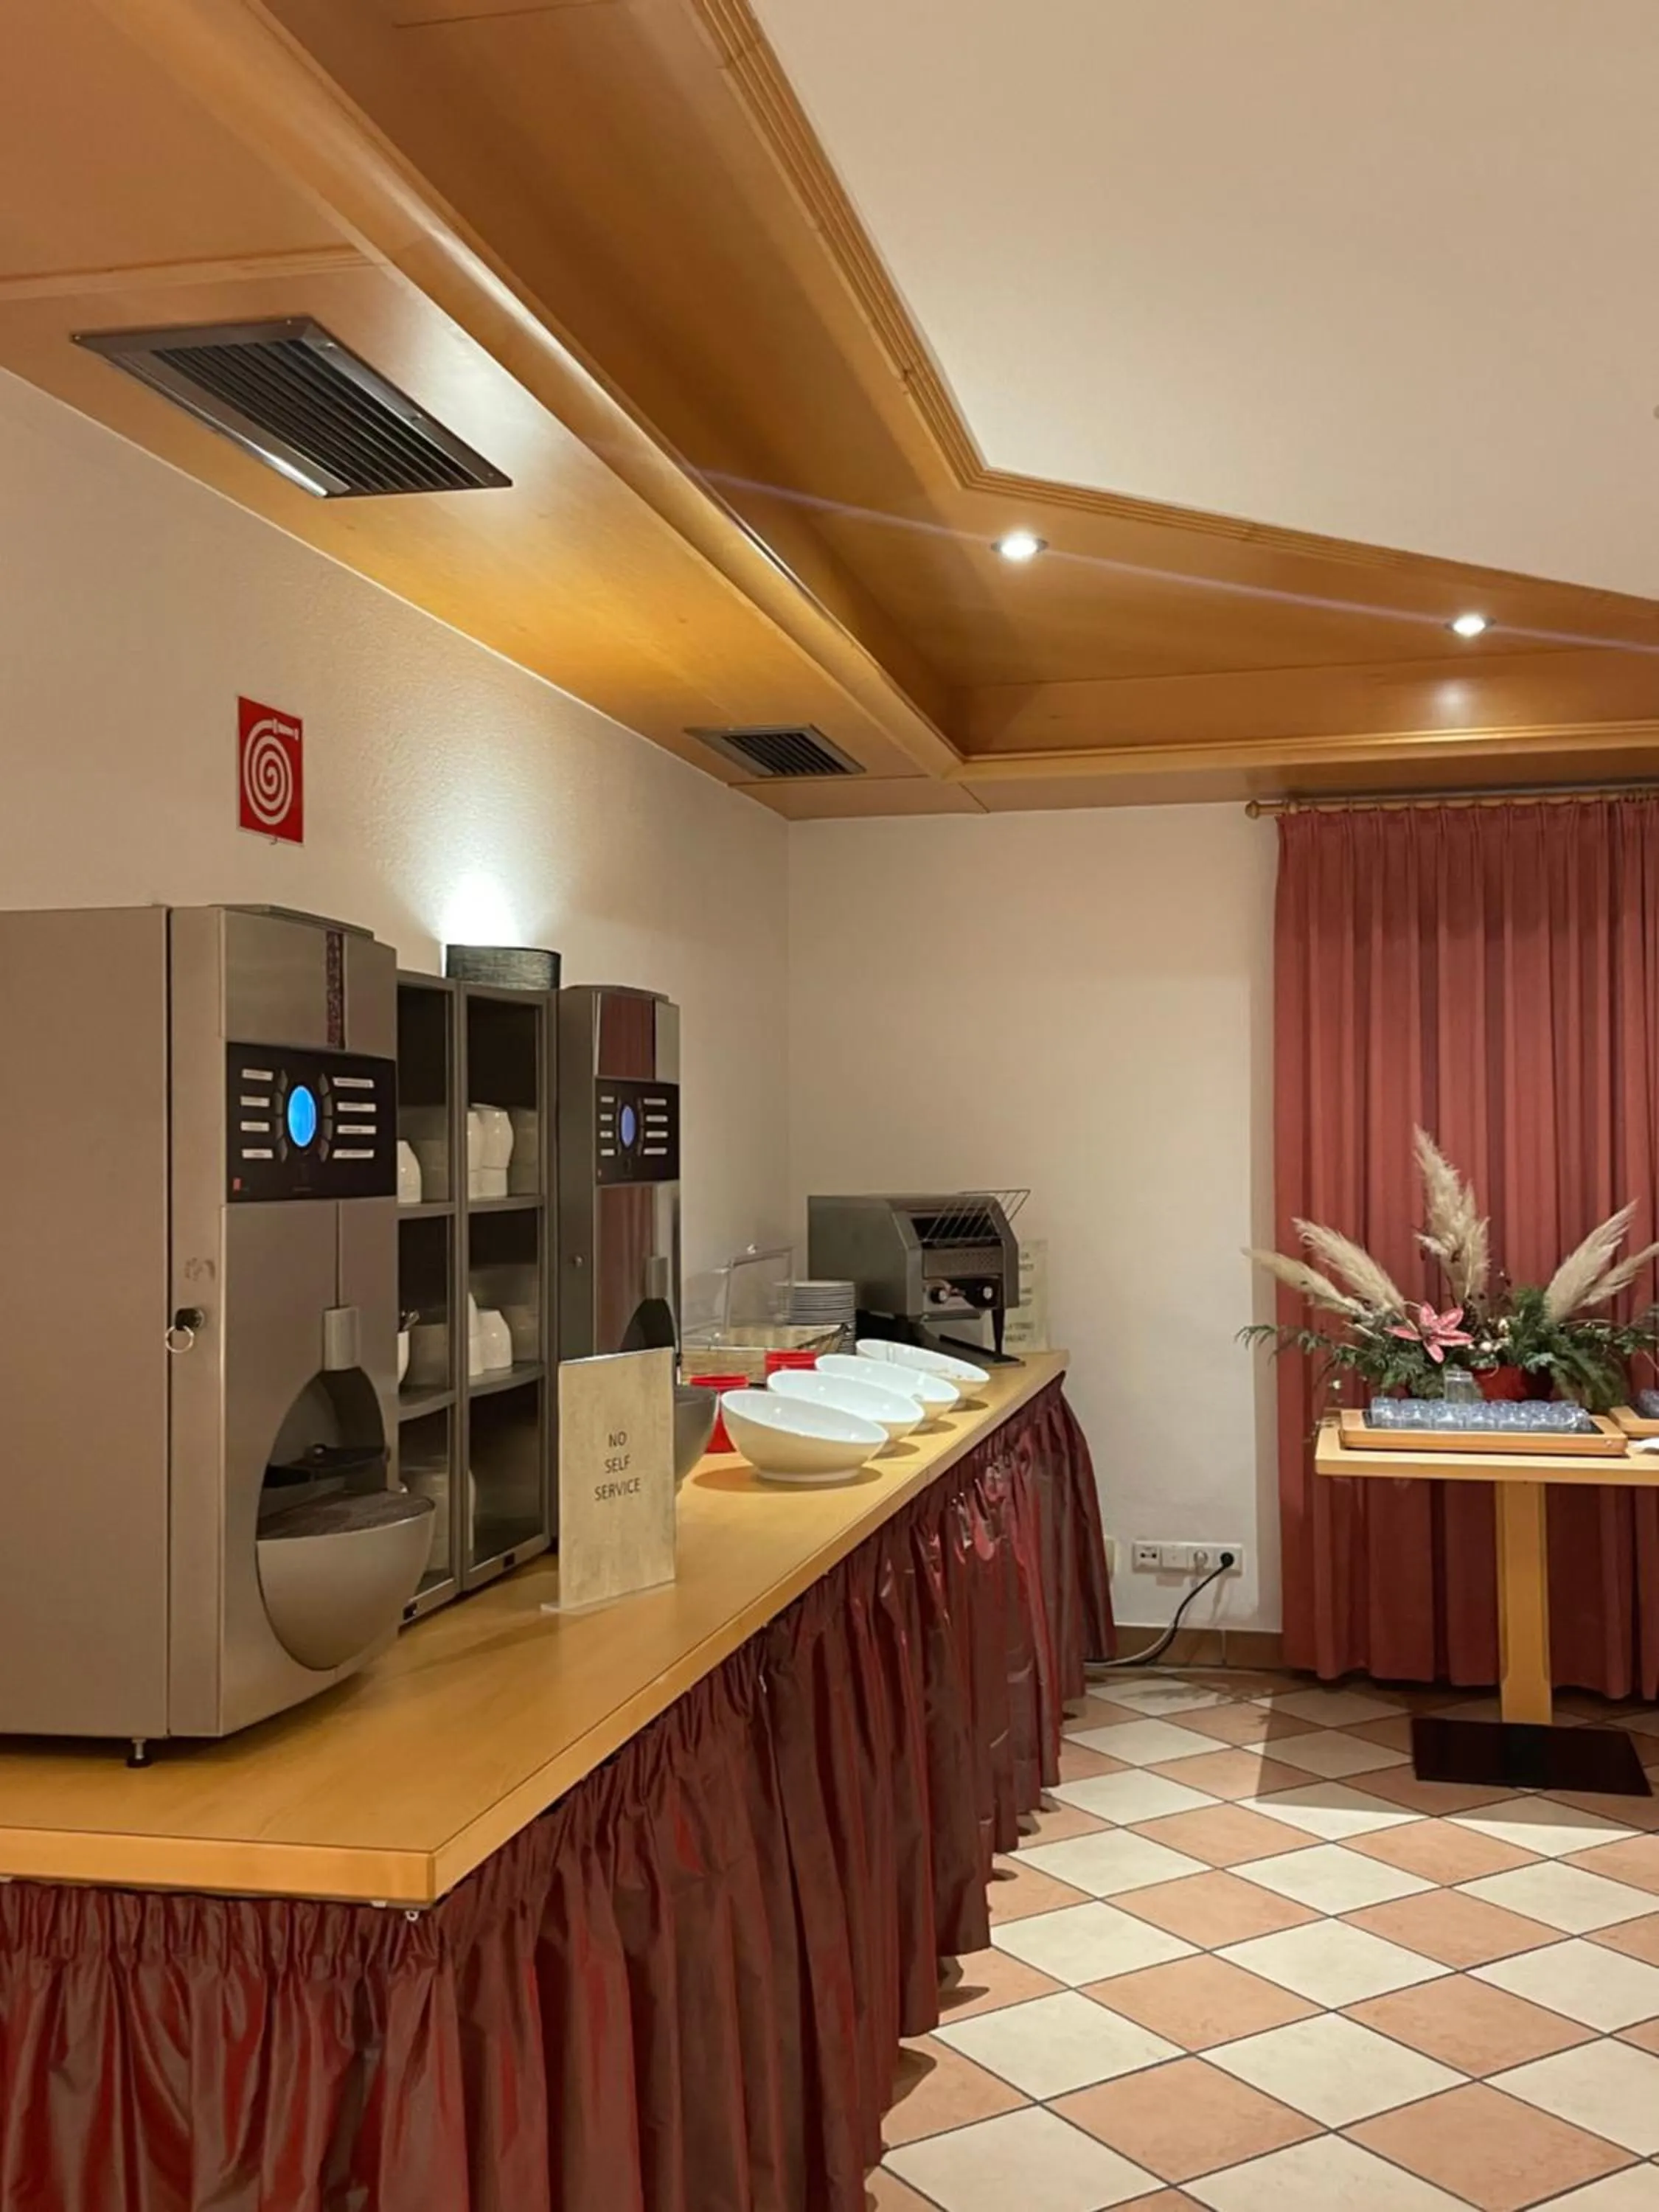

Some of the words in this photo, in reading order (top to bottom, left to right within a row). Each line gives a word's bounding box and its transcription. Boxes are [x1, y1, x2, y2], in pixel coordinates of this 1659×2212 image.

[608, 1431, 627, 1447] NO
[604, 1454, 630, 1473] SELF
[594, 1477, 641, 1501] SERVICE
